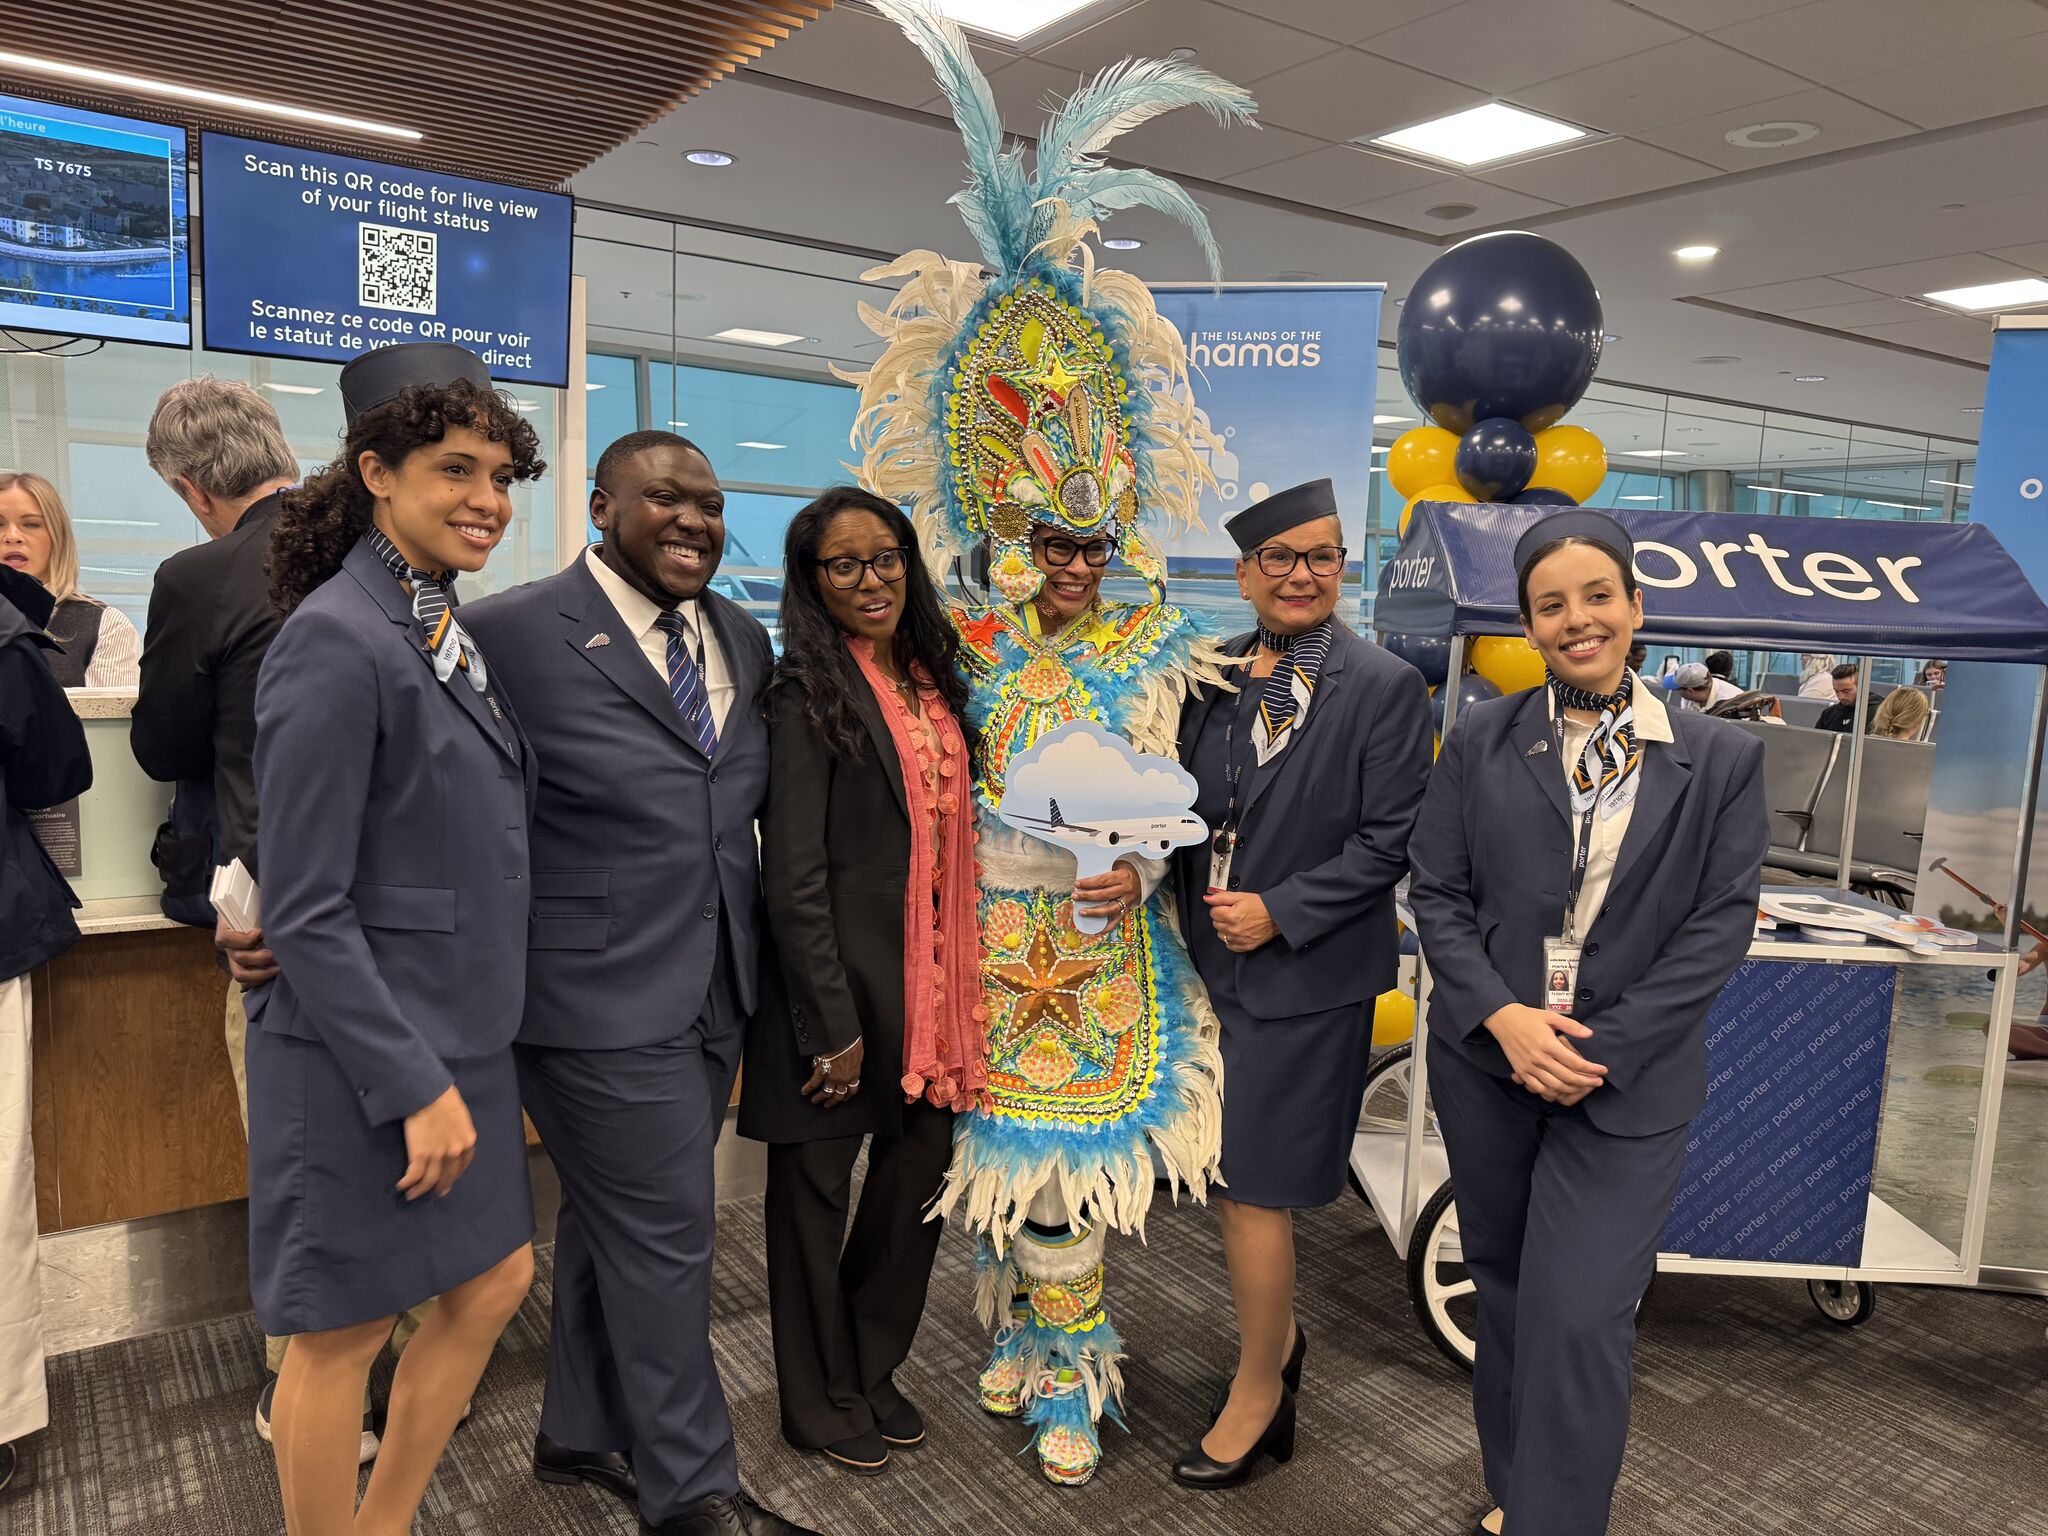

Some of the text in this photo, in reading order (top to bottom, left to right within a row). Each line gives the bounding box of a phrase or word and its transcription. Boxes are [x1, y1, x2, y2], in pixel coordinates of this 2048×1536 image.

[34, 157, 92, 177] TS 7675
[244, 154, 538, 219] Scan this QR code for live view
[302, 188, 490, 233] of your flight status
[250, 321, 268, 339] le
[273, 325, 334, 347] statut
[339, 332, 363, 349] de
[482, 349, 532, 369] direct
[251, 299, 531, 348] Scannez ce code QR pour voir
[1183, 332, 1320, 367] hamas
[1202, 330, 1321, 341] THE ISLANDS OF THE
[1389, 549, 1435, 599] porter
[1632, 533, 1922, 603] orter
[486, 697, 502, 719] porter
[1578, 845, 1587, 868] porter
[1704, 1016, 1739, 1051] porter
[1740, 987, 1774, 1021] porter
[1774, 962, 1809, 992] porter
[1736, 1037, 1770, 1071] porter
[1771, 1008, 1804, 1042] porter
[1806, 979, 1840, 1013] porter
[1702, 1108, 1736, 1140] porter
[1737, 1079, 1771, 1112] porter
[1772, 1050, 1806, 1083] porter
[1808, 1020, 1842, 1054] porter
[1843, 991, 1877, 1025] porter
[1702, 1151, 1735, 1184] porter
[1737, 1123, 1770, 1155] porter
[1772, 1093, 1806, 1127] porter
[1807, 1065, 1841, 1098] porter
[1843, 1036, 1876, 1070] porter
[1698, 1199, 1732, 1232] porter
[1733, 1171, 1766, 1204] porter
[1768, 1142, 1802, 1175] porter
[1803, 1114, 1838, 1148] porter
[1838, 1085, 1872, 1119] porter
[1734, 1211, 1767, 1244] porter
[1769, 1183, 1803, 1216] porter
[1804, 1155, 1838, 1188] porter
[1840, 1127, 1874, 1160] porter
[1769, 1226, 1803, 1259] porter
[1804, 1199, 1838, 1231] porter
[1839, 1171, 1872, 1203] porter
